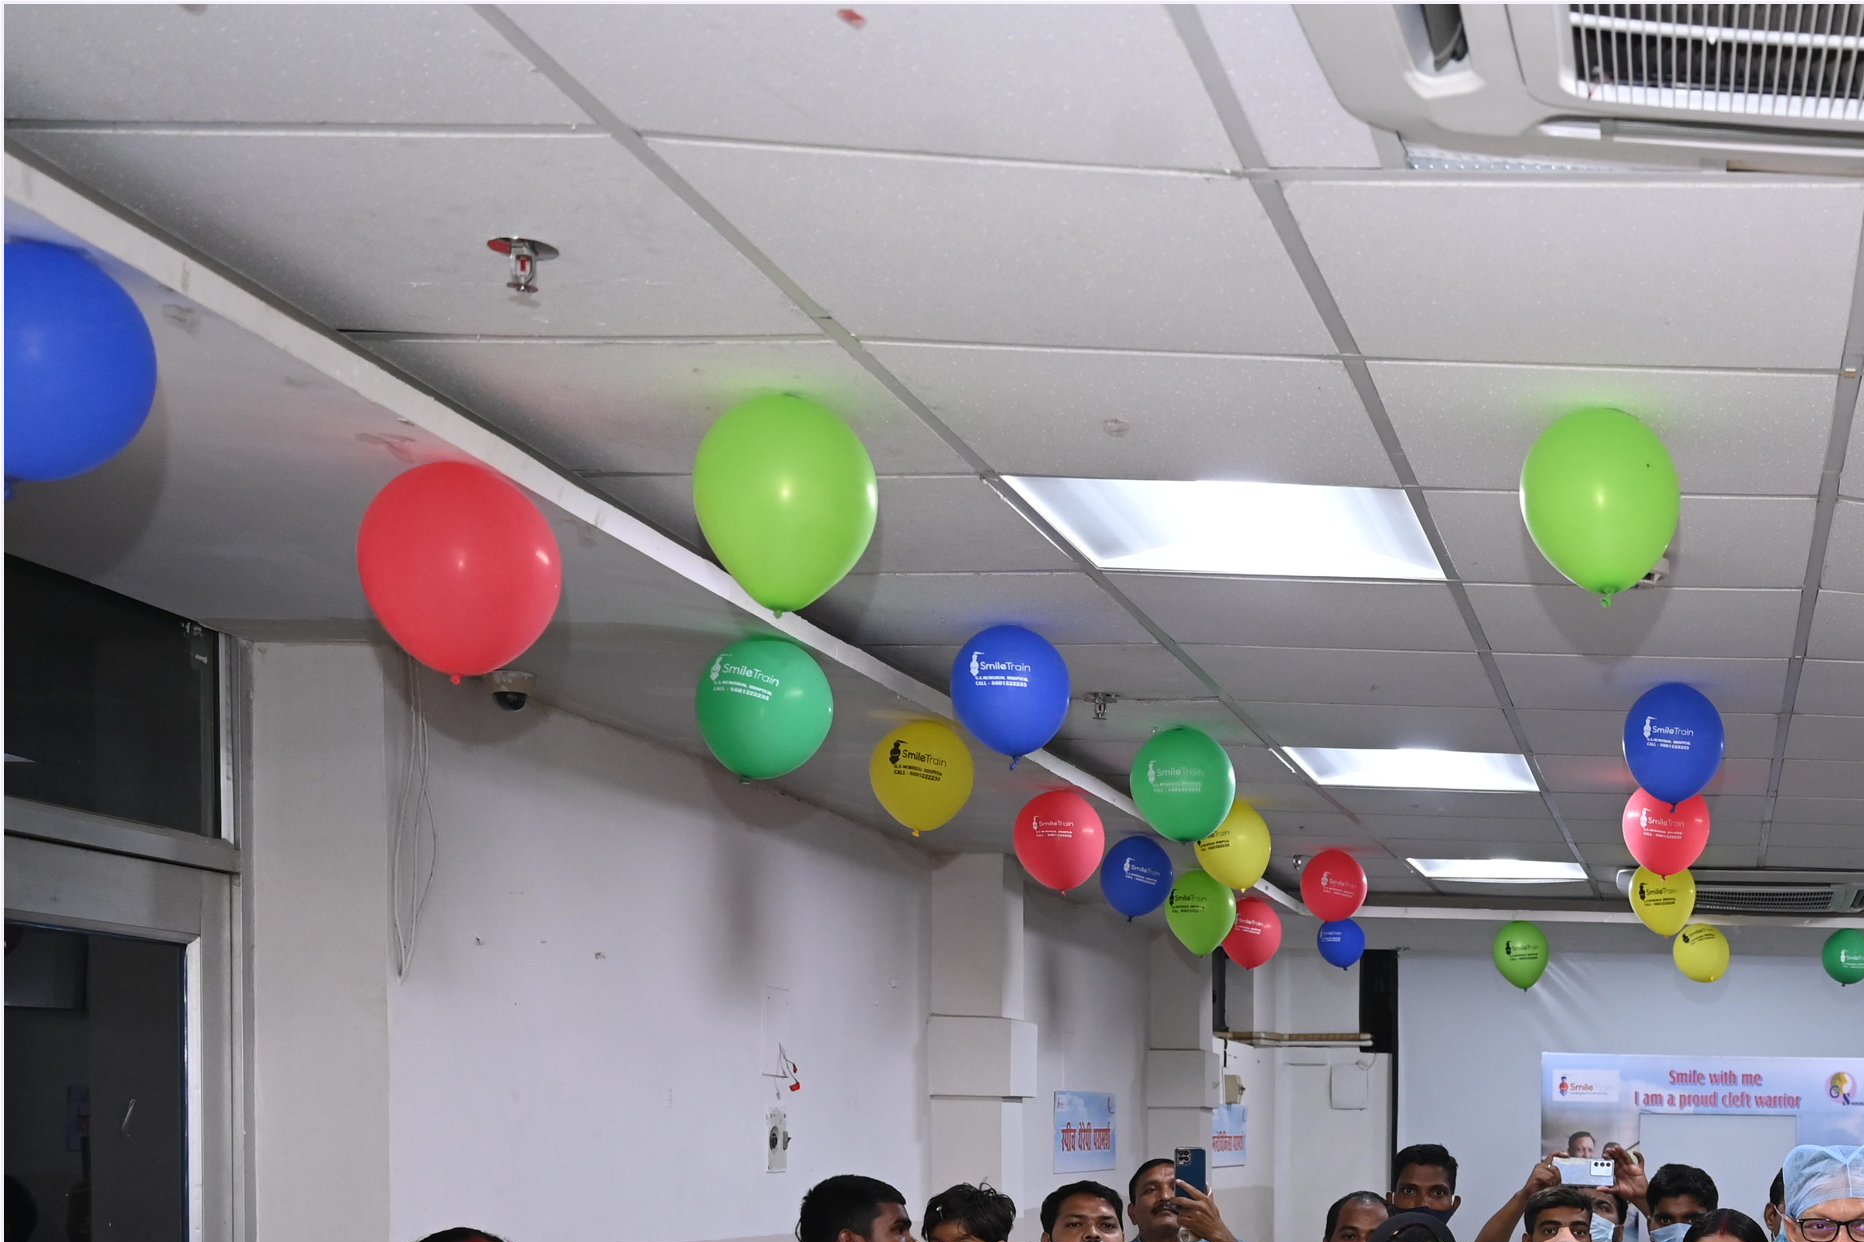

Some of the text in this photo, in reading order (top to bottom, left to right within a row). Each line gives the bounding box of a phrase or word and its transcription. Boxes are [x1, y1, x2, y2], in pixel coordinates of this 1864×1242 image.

[980, 661, 1030, 672] SmileTrain
[722, 663, 779, 687] SmileTrain
[1652, 726, 1694, 736] SmileTrain
[902, 749, 947, 767] SmileTrain
[1648, 817, 1685, 827] SmileTrain
[1669, 1070, 1763, 1086] Smile with me
[1634, 1091, 1802, 1109] I am a proud cleft warrior
